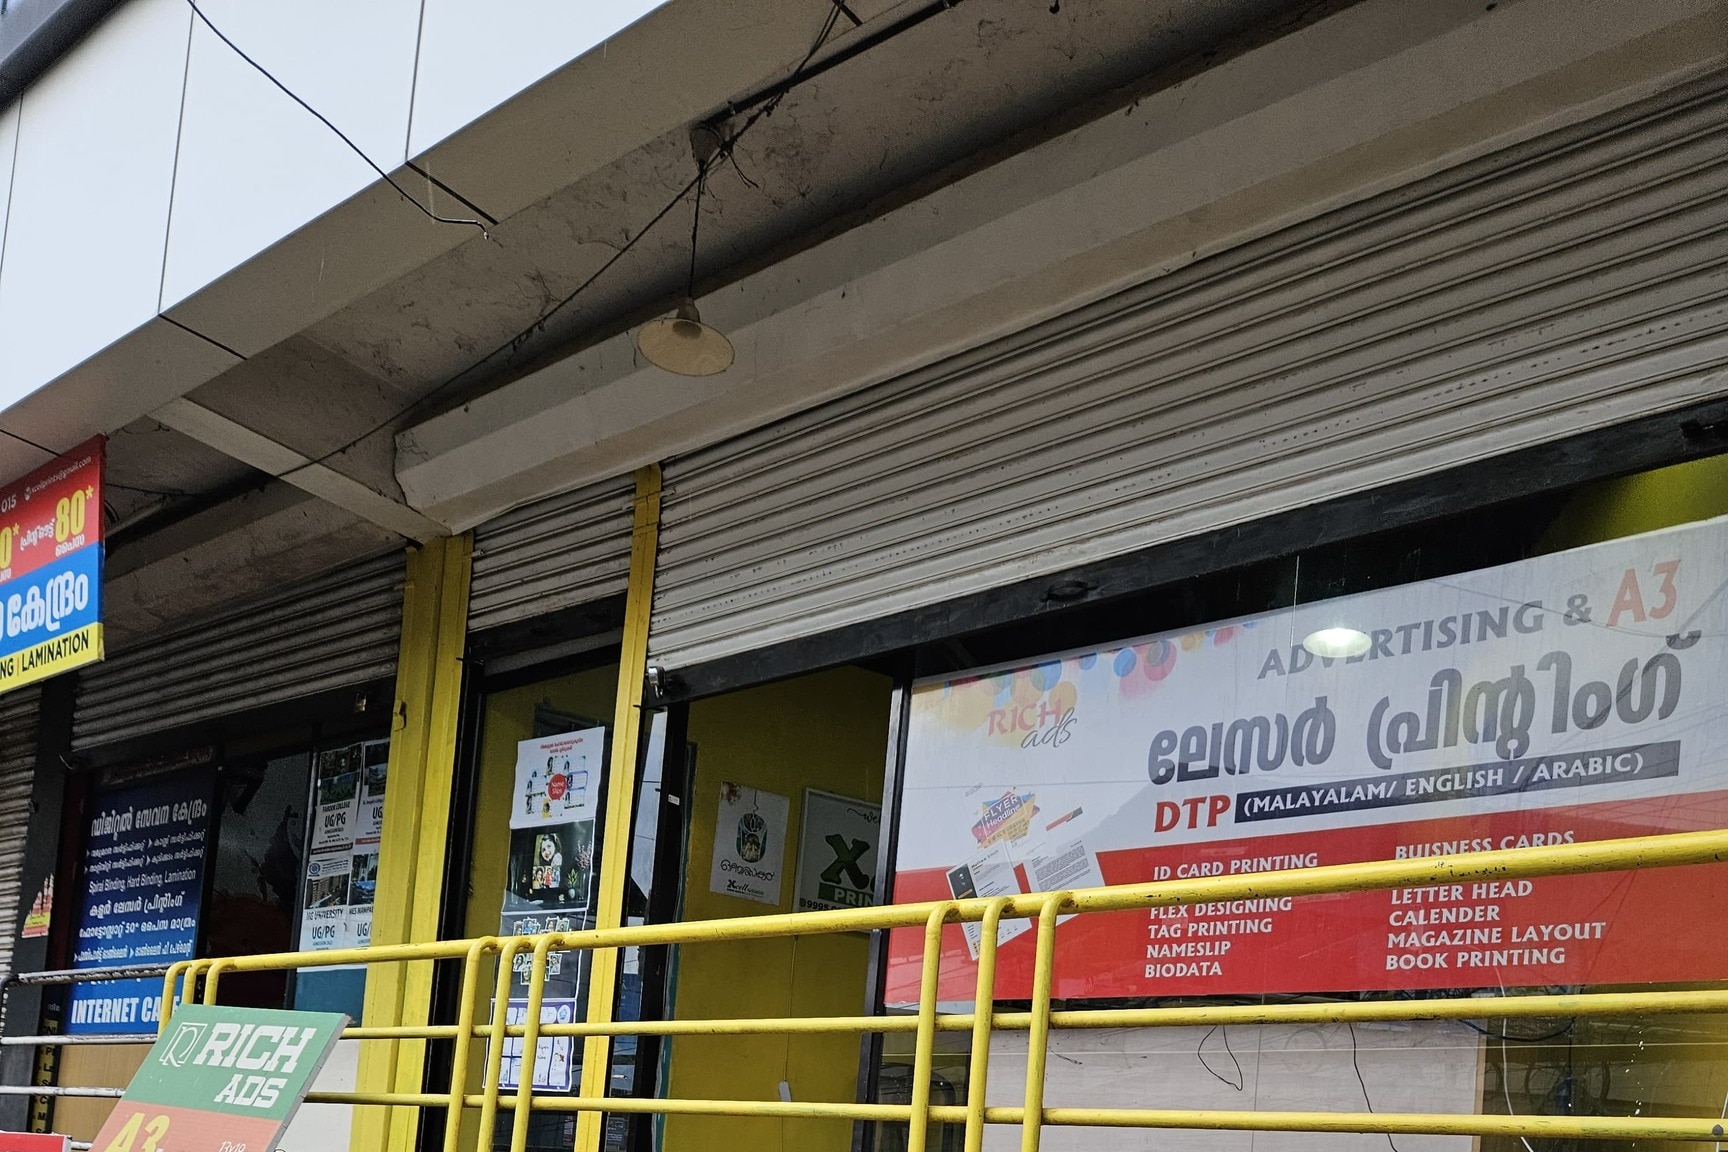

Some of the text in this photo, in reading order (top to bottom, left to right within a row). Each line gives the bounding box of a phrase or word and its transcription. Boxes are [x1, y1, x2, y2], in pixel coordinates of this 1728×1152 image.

[7, 571, 89, 637] കേന്ദ്രം
[1257, 559, 1682, 680] ADRTISING & A3
[21, 629, 89, 672] LAMINATION
[987, 698, 1061, 737] RICH
[1020, 707, 1077, 749] ads
[1148, 696, 1336, 785] ലേസർ
[1154, 794, 1231, 832] DTP
[1405, 769, 1503, 795] ENGLISH
[1533, 752, 1643, 783] ARABIC)
[324, 812, 346, 828] UG/PG
[984, 795, 1019, 820] FLYER
[1395, 830, 1574, 860] BUISNESS CARDS
[1153, 853, 1318, 881] ID CARD PRINTING
[1391, 880, 1533, 905] LETTER HEAD
[1150, 897, 1292, 919] FLEX DESIGNING
[1389, 905, 1500, 926] CALENDER
[312, 925, 335, 939] UG/PG
[1148, 918, 1273, 939] TAG PRINTING
[1387, 921, 1606, 948] MAGAZINE LAYOUT
[1146, 941, 1231, 958] NAMESLIP
[1386, 947, 1566, 970] BOOK PRINTING
[1145, 961, 1223, 978] BIODATA
[71, 995, 181, 1024] INTERNET CAE
[192, 1023, 317, 1073] RICH
[213, 1074, 288, 1108] ADS
